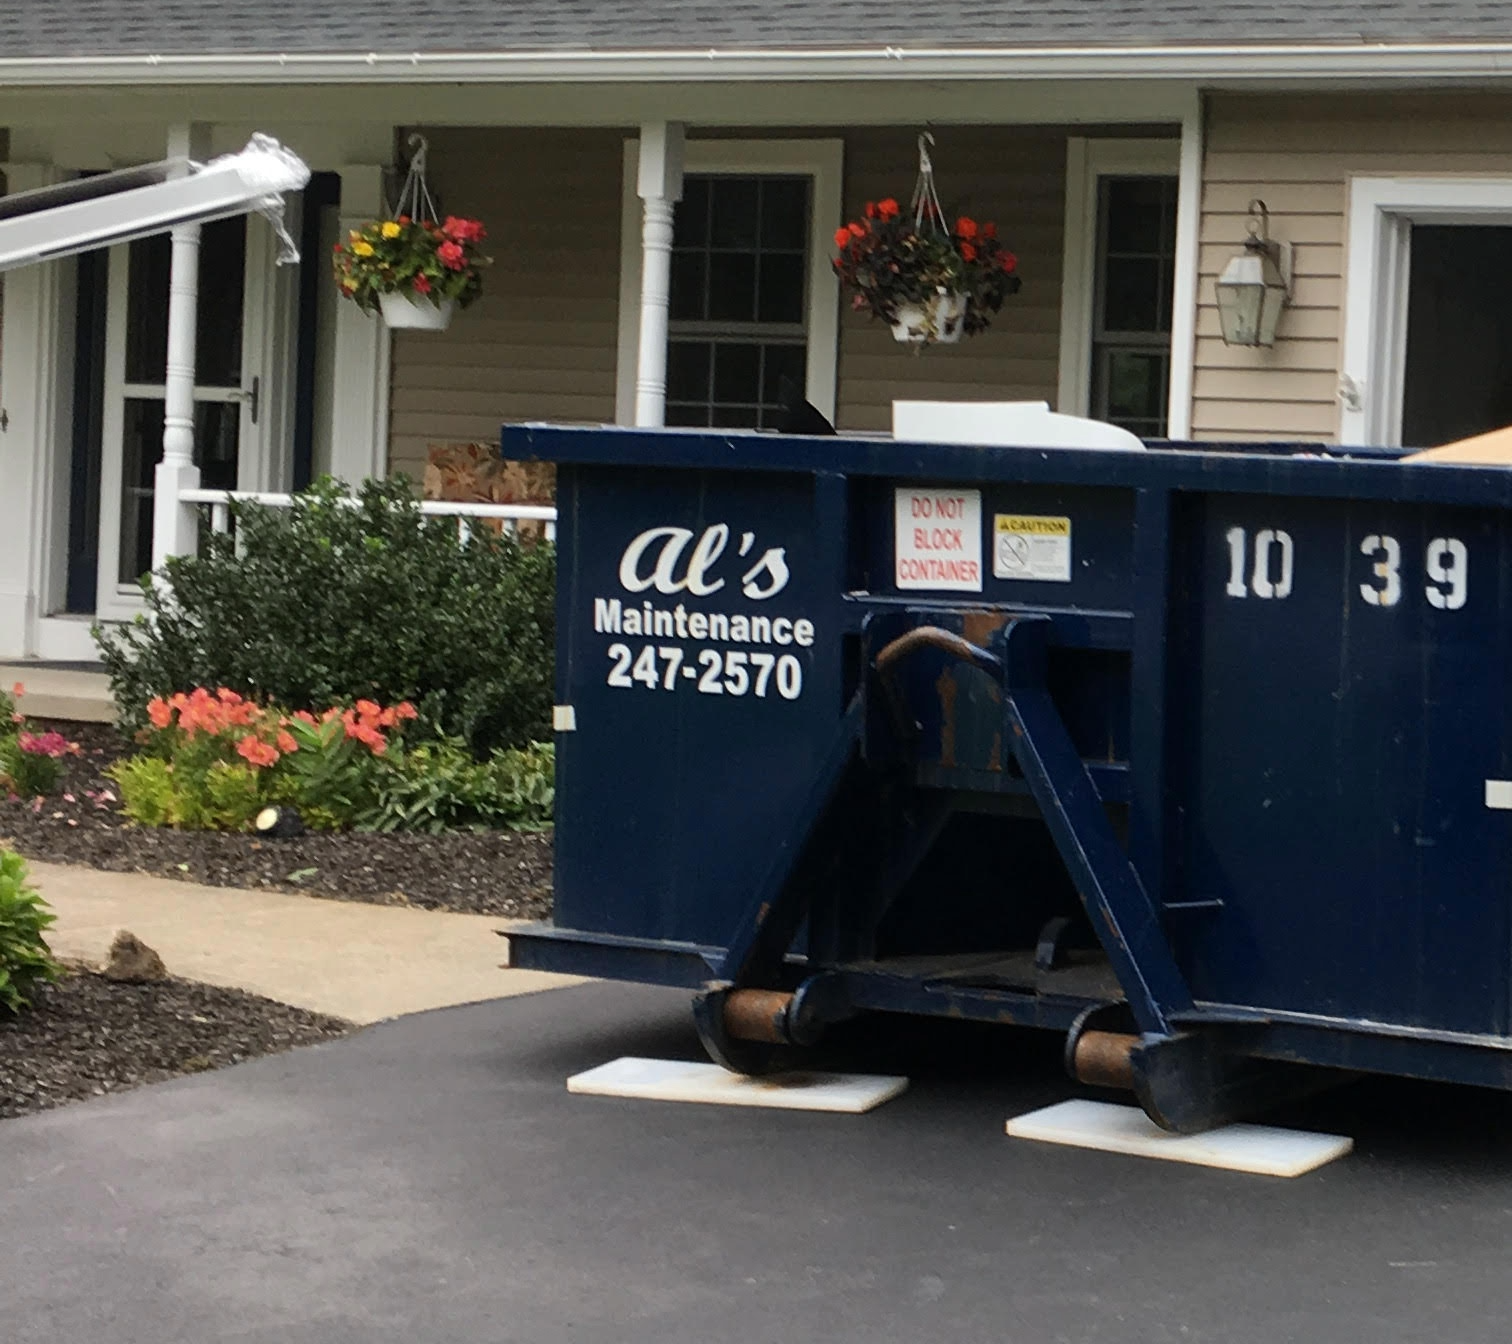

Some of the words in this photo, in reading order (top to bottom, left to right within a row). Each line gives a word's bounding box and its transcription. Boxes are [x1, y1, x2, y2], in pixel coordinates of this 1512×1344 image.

[911, 496, 933, 518] DO
[935, 497, 966, 520] NOT
[913, 527, 963, 551] BLOCK
[1010, 520, 1066, 533] CAUTION
[618, 522, 791, 600] Al's
[899, 558, 979, 582] CONTAINER
[1225, 527, 1294, 599] 10
[594, 598, 815, 647] Maintenance
[607, 644, 803, 700] 247-2570
